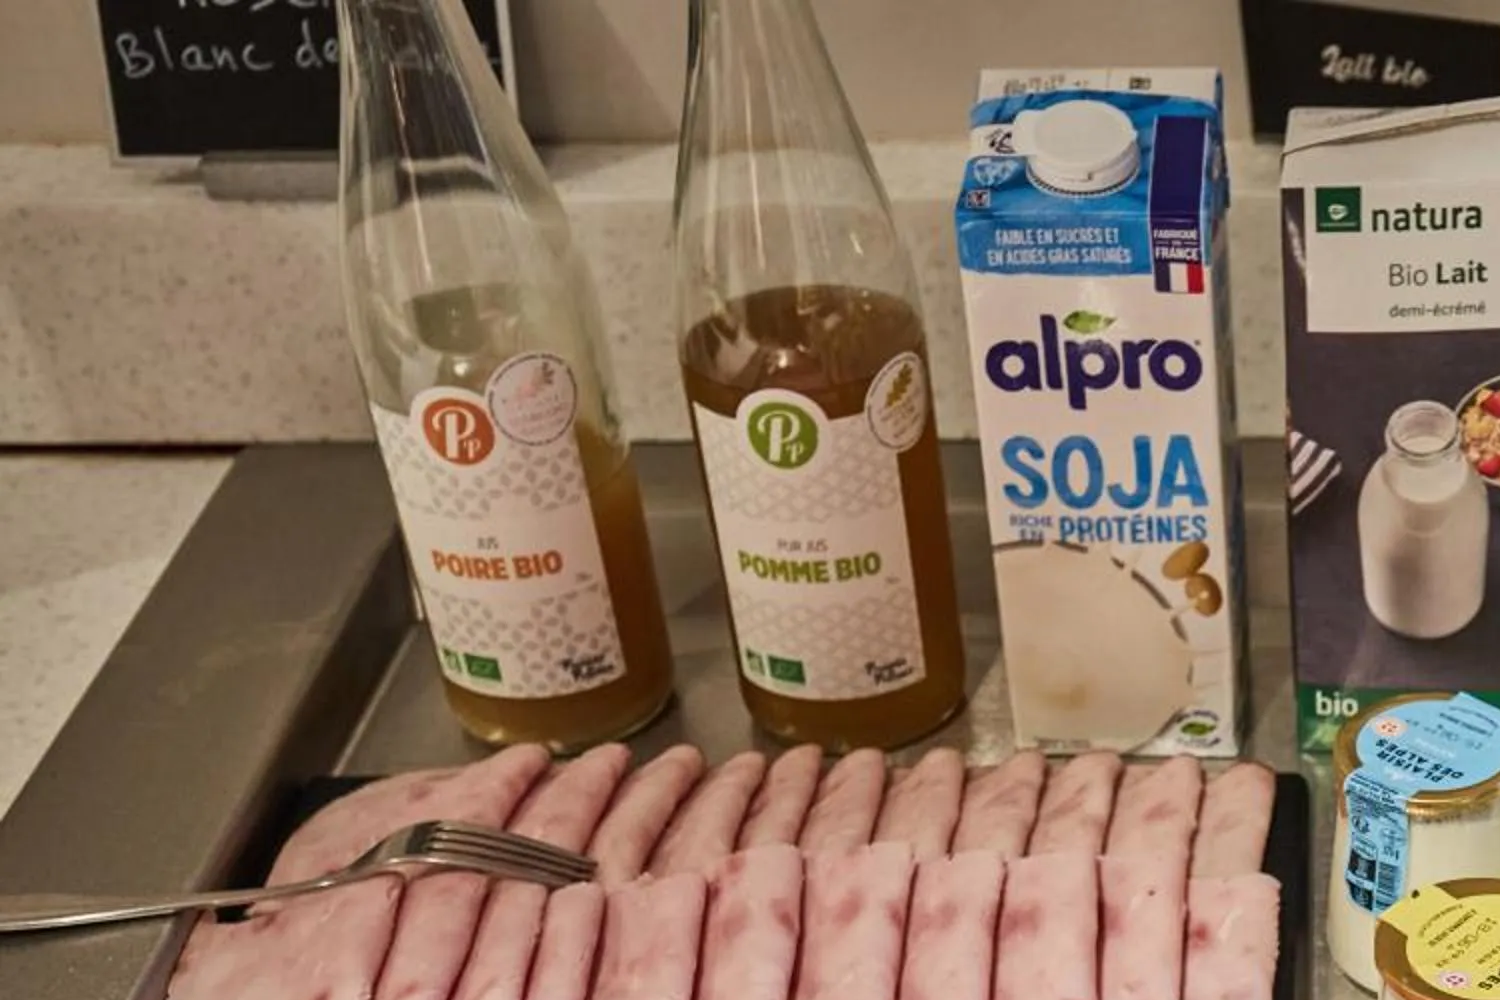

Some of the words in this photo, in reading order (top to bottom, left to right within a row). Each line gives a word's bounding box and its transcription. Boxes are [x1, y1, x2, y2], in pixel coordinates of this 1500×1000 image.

[116, 26, 273, 80] Blanc
[294, 20, 340, 70] de
[1381, 47, 1431, 88] bio
[1371, 202, 1483, 232] natura
[1104, 227, 1119, 244] ET
[1154, 247, 1199, 261] FRANCE
[1388, 263, 1429, 287] Bio
[1436, 260, 1489, 285] Lait
[1388, 300, 1486, 319] demi-écrémé
[985, 314, 1203, 410] alpro
[1001, 434, 1209, 510] SOJA
[1058, 513, 1208, 544] PROTÉINES
[431, 550, 509, 580] POIRE
[512, 551, 563, 579] BIO
[738, 550, 830, 584] POMME
[835, 552, 881, 581] BIO
[1315, 690, 1359, 717] bio
